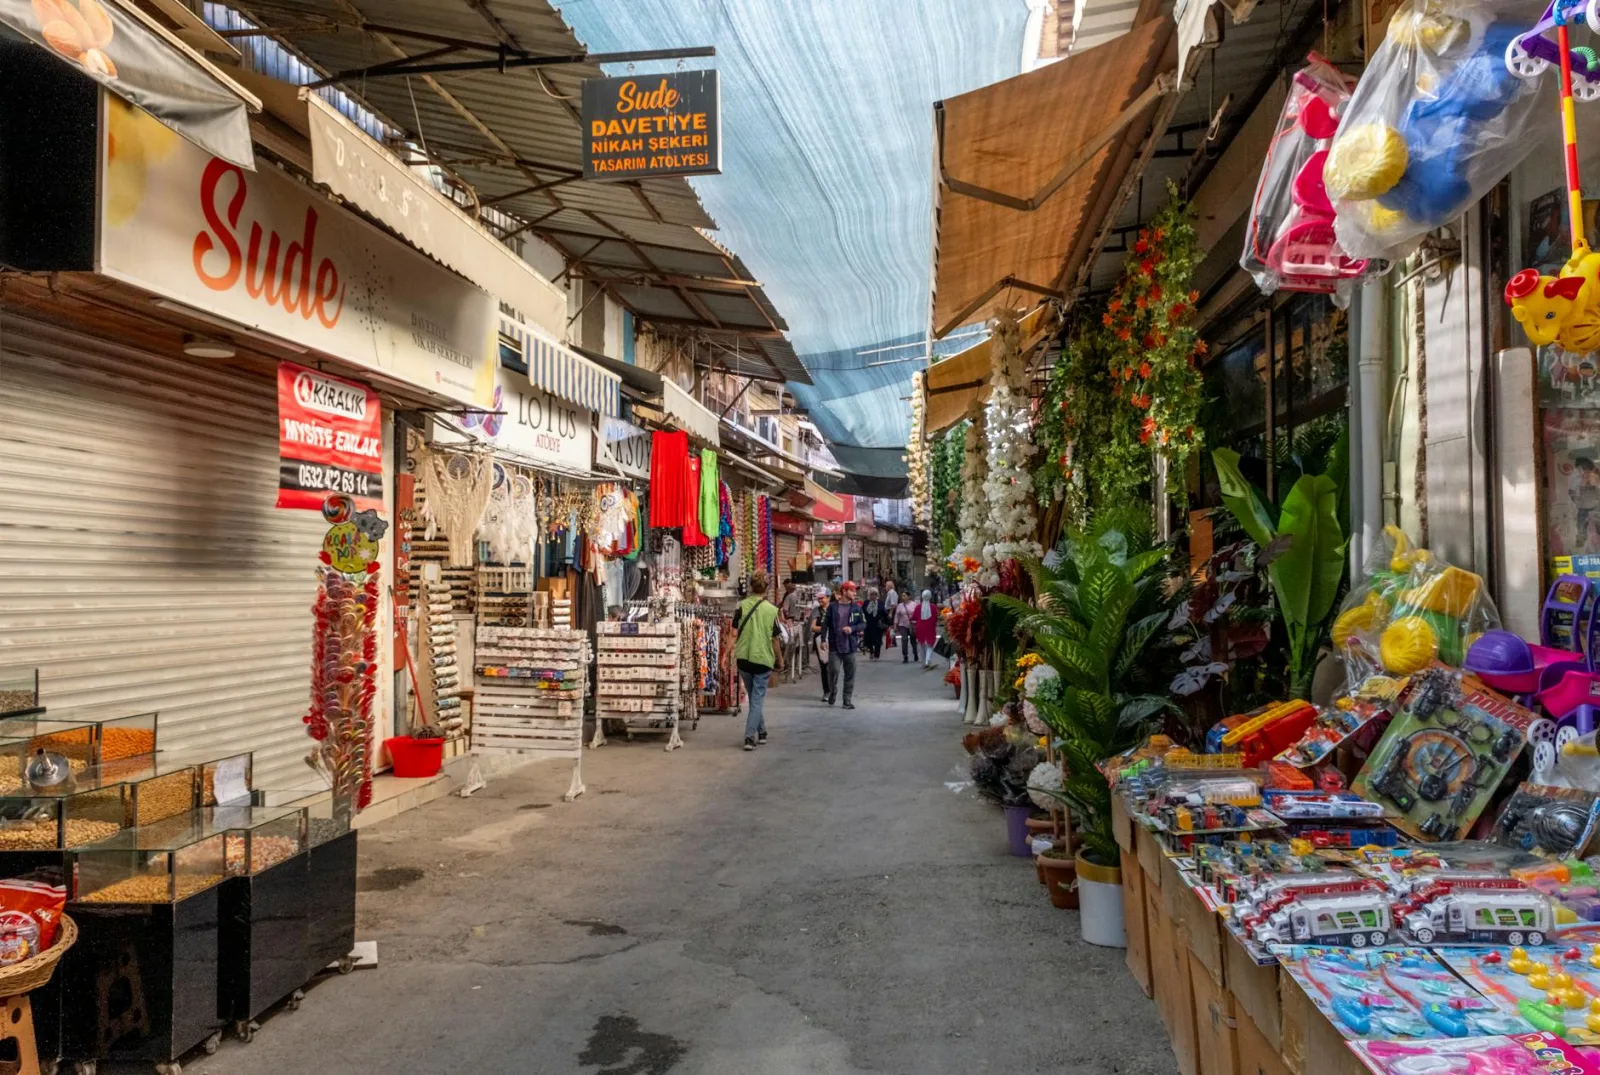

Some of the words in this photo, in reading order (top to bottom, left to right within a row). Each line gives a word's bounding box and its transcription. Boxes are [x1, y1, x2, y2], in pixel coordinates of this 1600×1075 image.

[616, 78, 680, 113] Sude
[591, 112, 707, 137] DAVETİYE
[591, 138, 643, 154] NİKAH
[648, 132, 708, 152] ŞEKERİ
[592, 157, 647, 172] TASARIM
[192, 156, 346, 329] Sude
[313, 379, 365, 416] KİRALIK
[518, 391, 577, 440] LOTUS
[284, 417, 333, 449] MYSİTE
[335, 430, 379, 458] EMLAK
[299, 464, 324, 489] 0532
[342, 471, 355, 493] 63
[356, 474, 368, 495] 14
